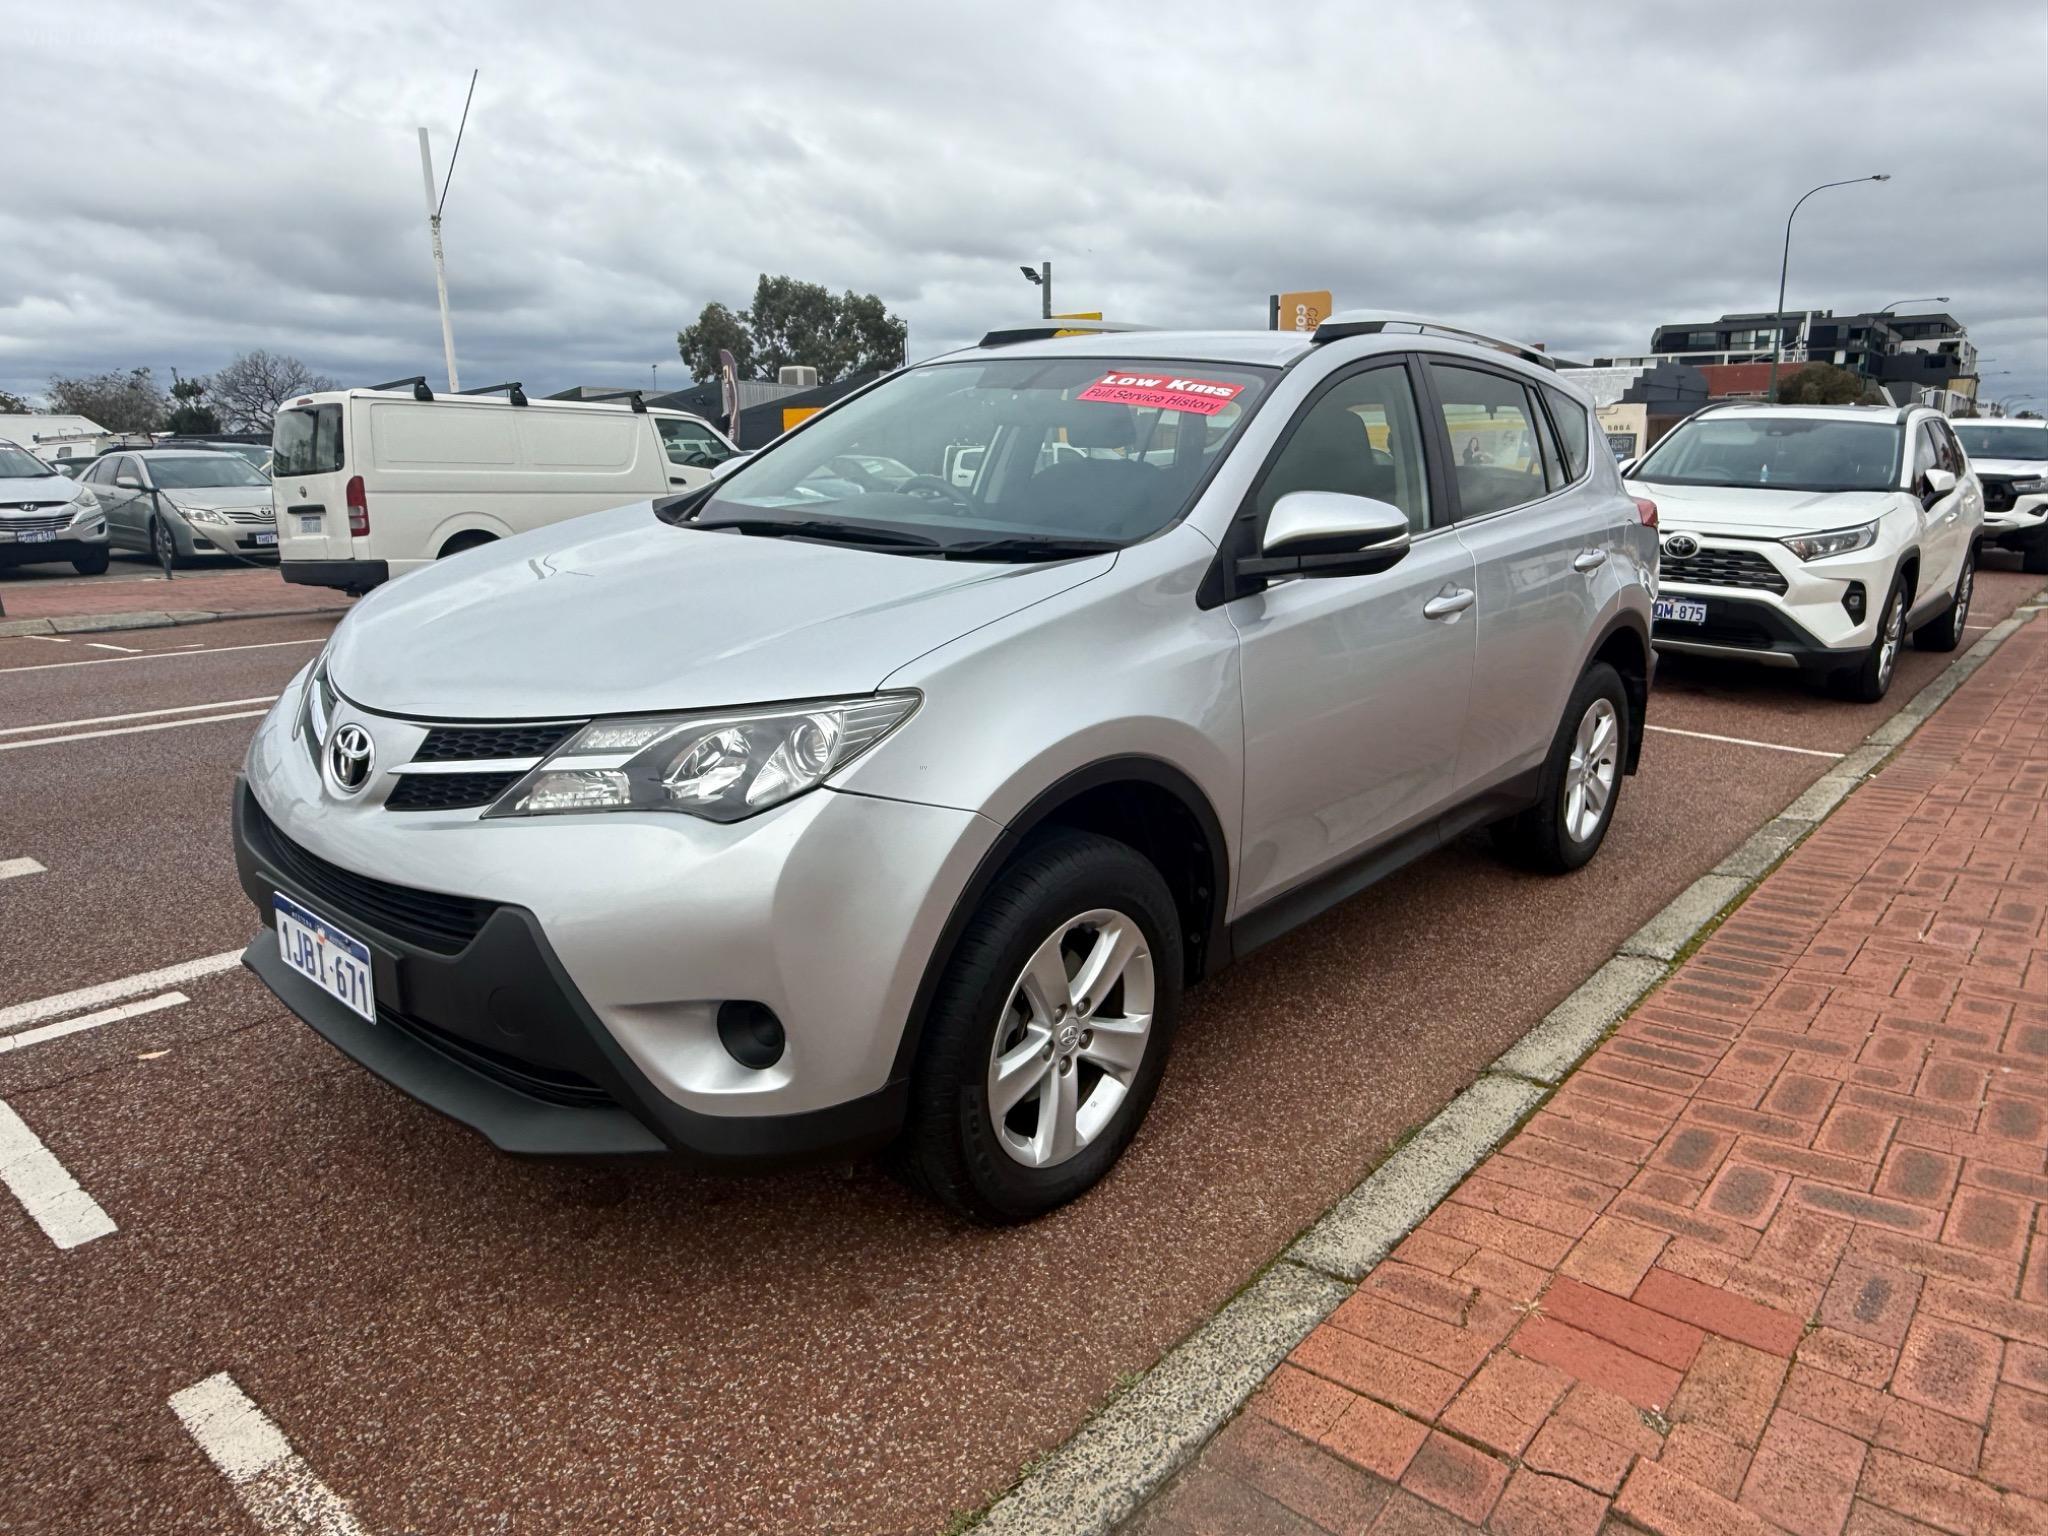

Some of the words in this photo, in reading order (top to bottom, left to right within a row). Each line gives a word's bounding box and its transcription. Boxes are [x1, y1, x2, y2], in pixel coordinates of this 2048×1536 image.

[1102, 375, 1160, 388] Low
[1166, 379, 1234, 397] Kms
[1087, 388, 1114, 398] Full
[1114, 390, 1165, 403] Service
[1165, 395, 1220, 412] History
[1655, 603, 1704, 621] QM-875
